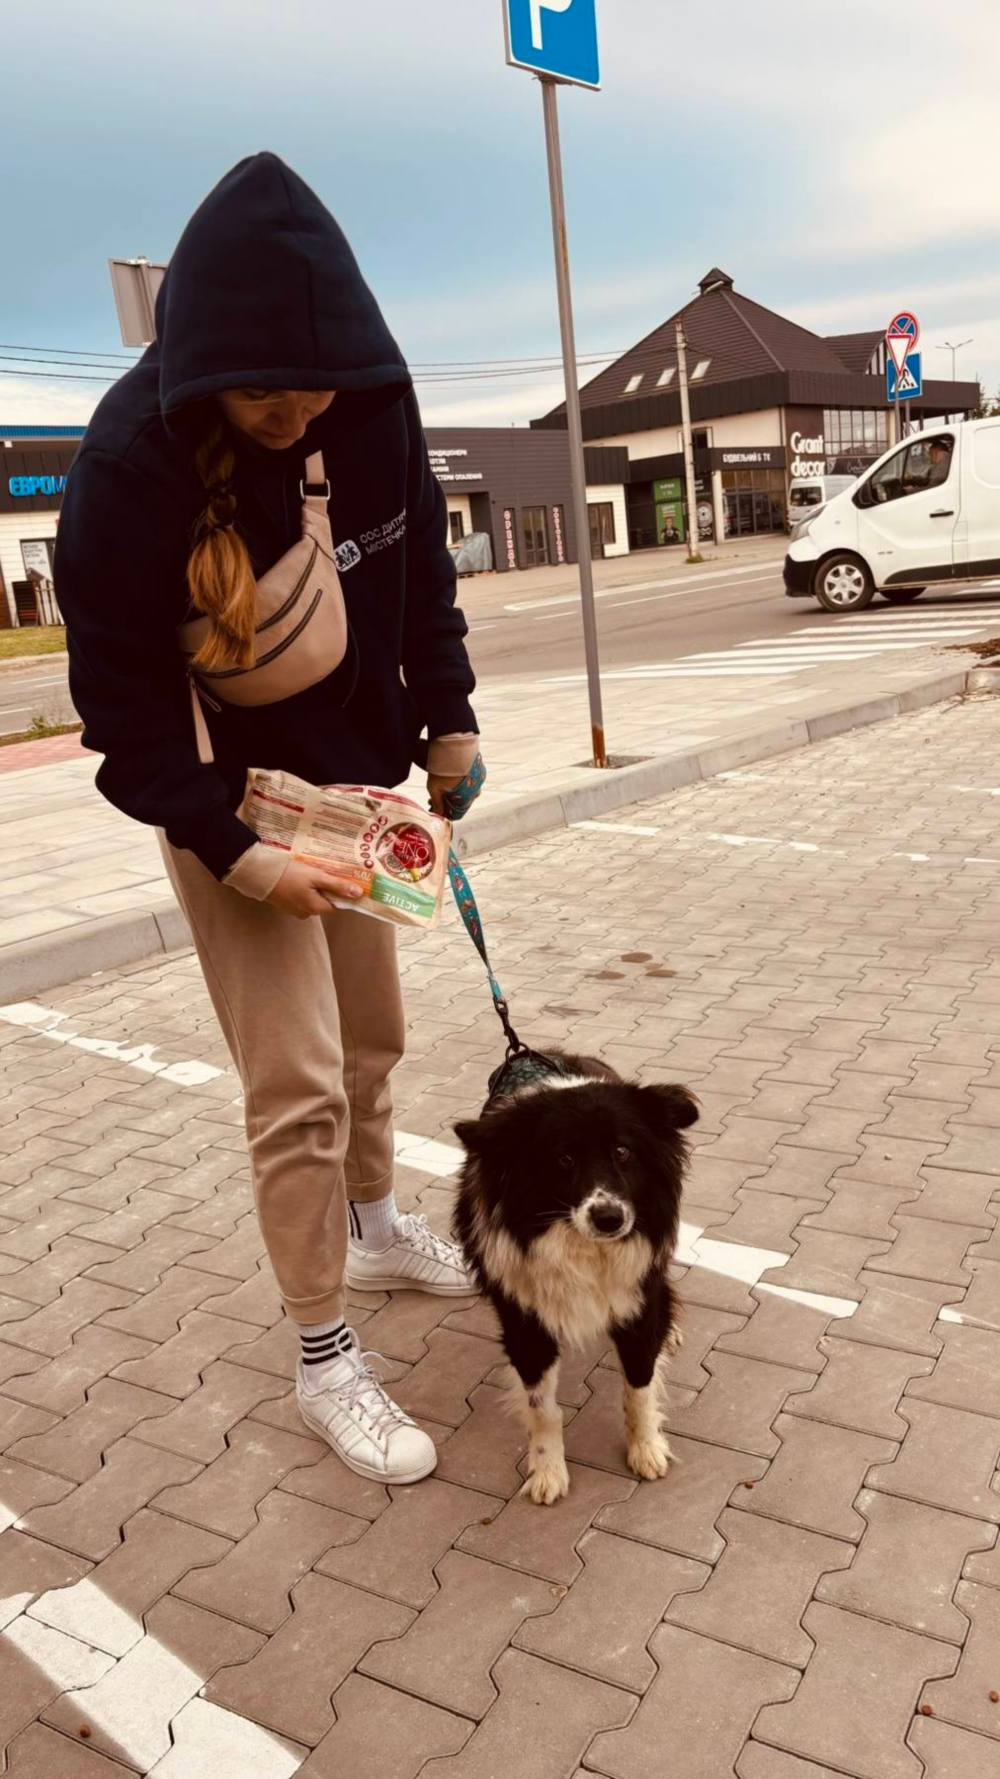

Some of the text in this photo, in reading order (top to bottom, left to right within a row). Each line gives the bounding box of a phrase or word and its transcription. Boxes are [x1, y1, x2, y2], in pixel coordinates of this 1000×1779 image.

[529, 0, 573, 50] P
[790, 431, 823, 454] Grant
[790, 455, 825, 477] decor
[360, 528, 381, 544] СОС
[398, 841, 429, 860] ONE
[382, 892, 421, 913] ACTIVE
